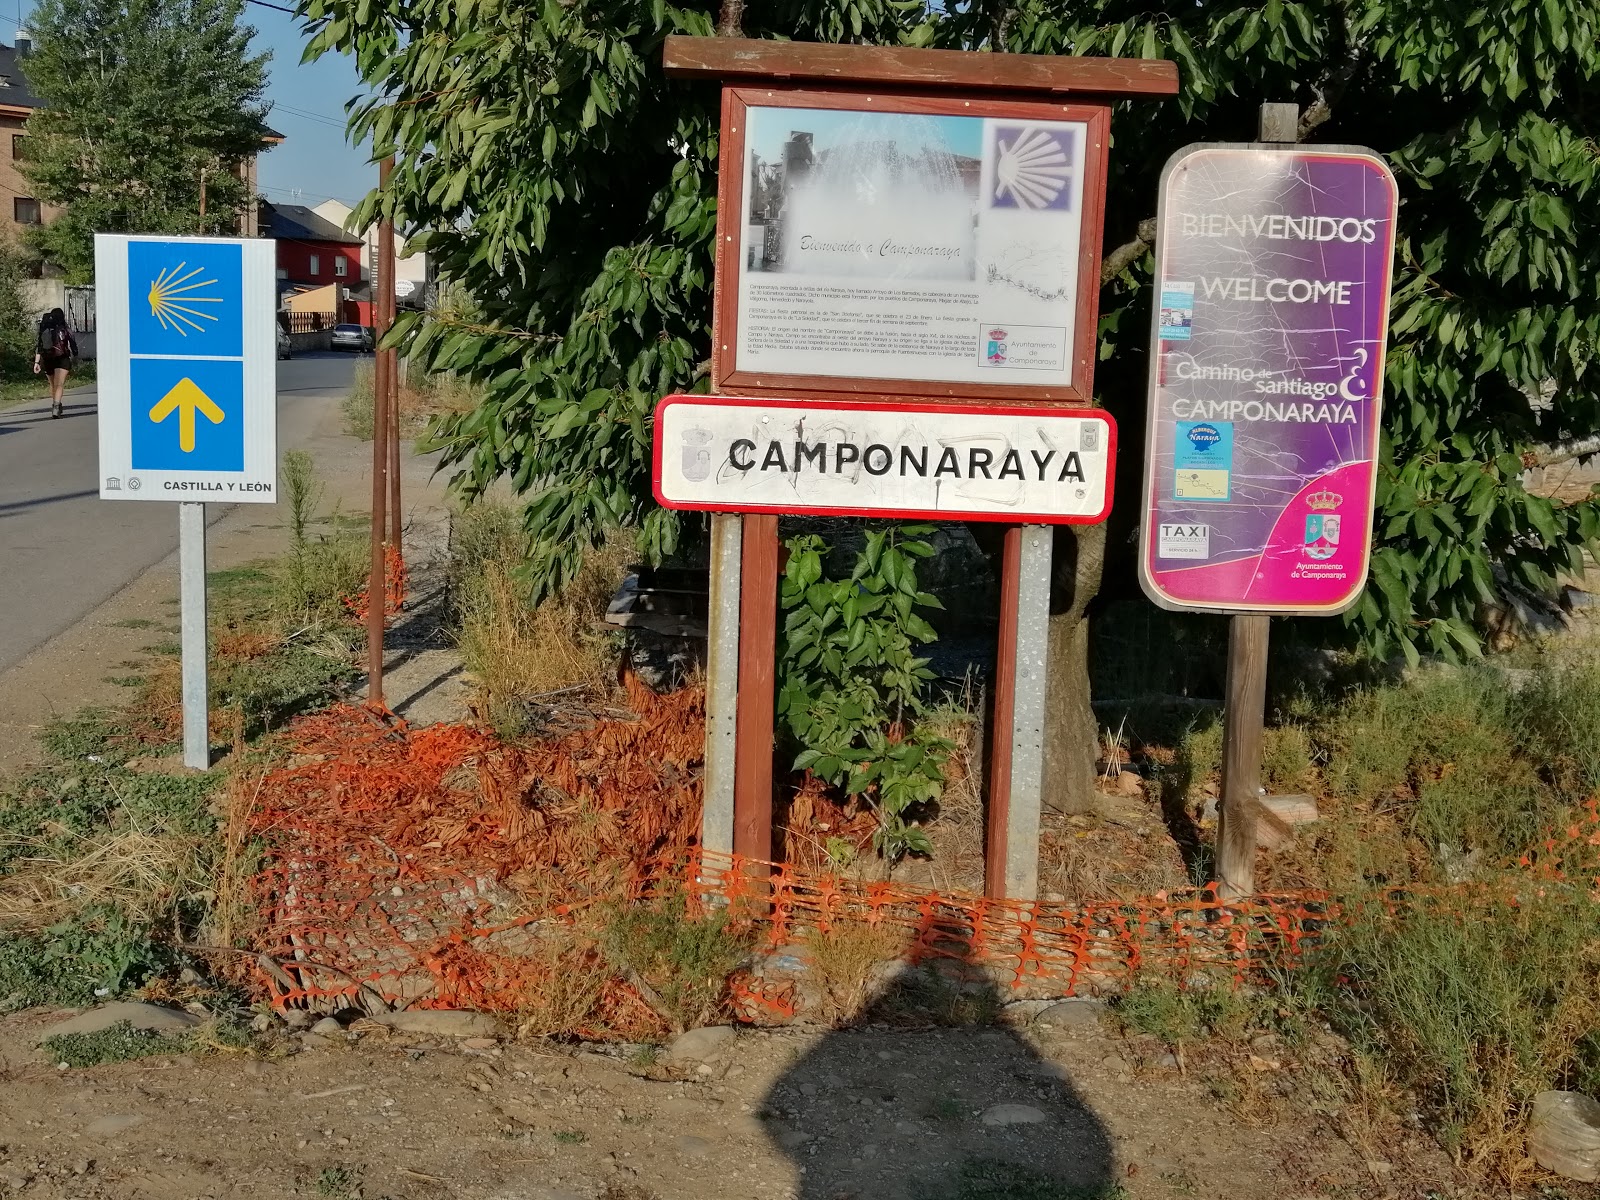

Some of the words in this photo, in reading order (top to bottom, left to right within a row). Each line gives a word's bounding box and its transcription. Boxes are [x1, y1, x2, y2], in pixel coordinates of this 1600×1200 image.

[1182, 214, 1376, 243] BIENVENIDOS
[800, 234, 862, 253] Bienvenido
[866, 243, 873, 253] a
[879, 238, 961, 260] Camponaraya
[1201, 276, 1352, 305] WELCOME
[1009, 356, 1057, 366] Camponaraya
[1176, 361, 1255, 382] Camino
[1258, 369, 1272, 379] de
[1255, 377, 1338, 400] santiago
[1172, 398, 1358, 424] CAMPONARAYA
[1190, 434, 1220, 444] Naraya
[728, 437, 1087, 483] CAMPONARAYA
[164, 481, 223, 491] CASTILLA
[227, 482, 236, 491] Y
[239, 481, 272, 492] LEÓN
[1162, 525, 1206, 537] TAXI
[1296, 562, 1343, 571] Ayuntamiento
[1302, 571, 1346, 580] Camponaraya
